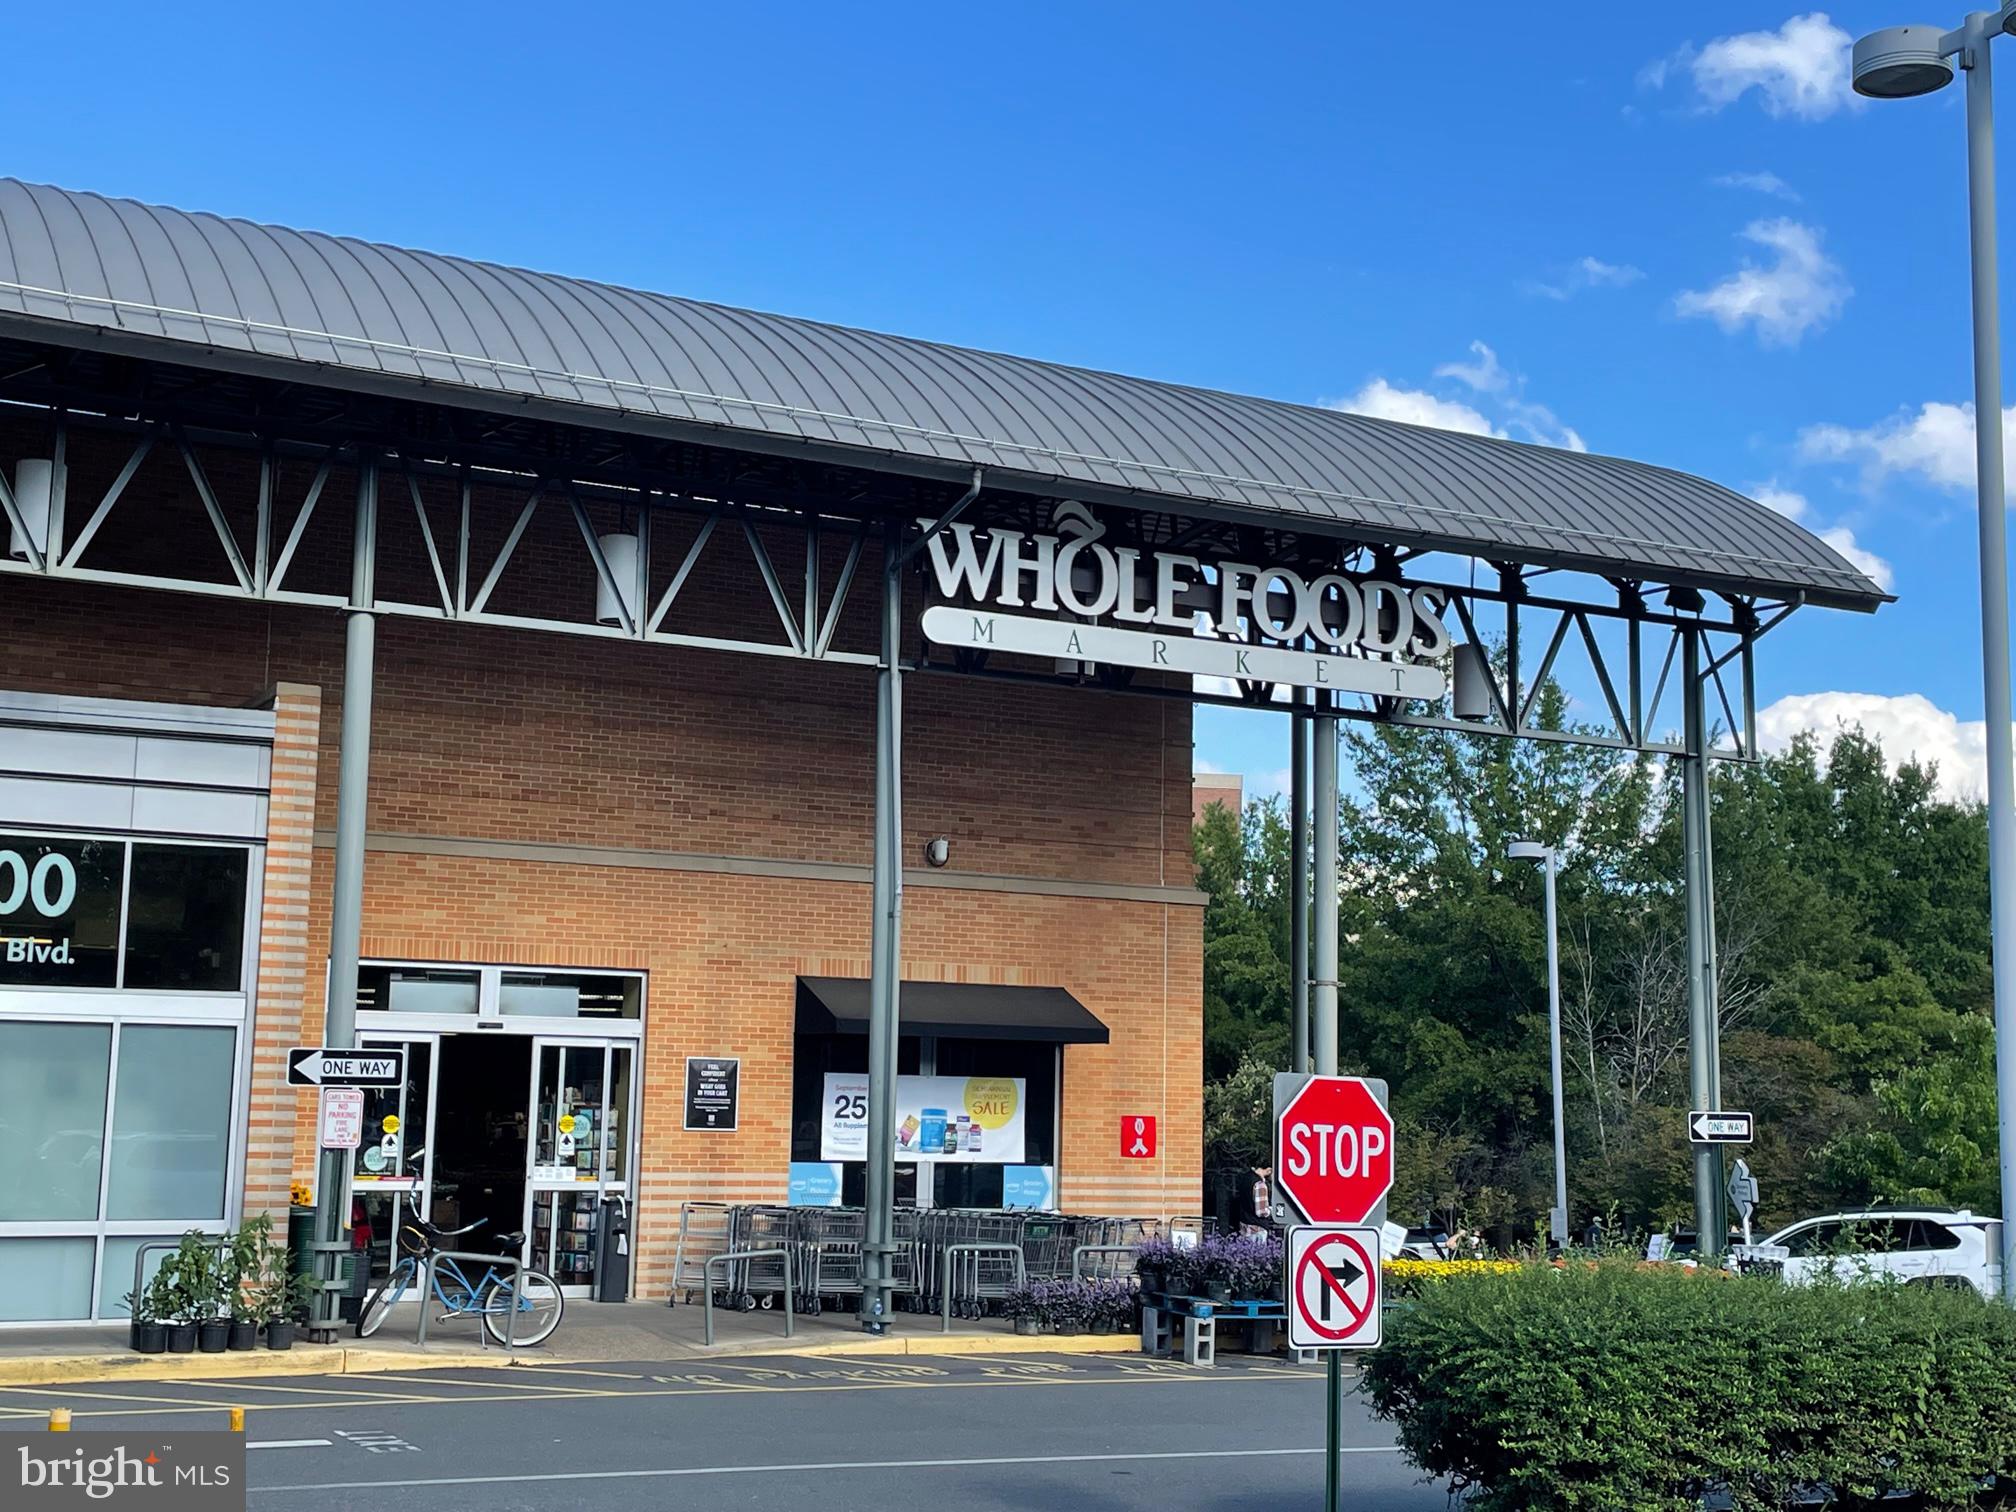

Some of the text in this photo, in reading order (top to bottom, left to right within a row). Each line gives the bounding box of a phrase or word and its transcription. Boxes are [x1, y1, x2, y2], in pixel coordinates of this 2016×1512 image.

[916, 500, 1451, 657] WHOLE FOODS
[972, 616, 1405, 691] MARKET
[7, 936, 75, 964] Blvd.
[322, 1060, 391, 1075] ONE WAY
[328, 1111, 357, 1119] PARKING
[972, 1100, 1009, 1115] SALE
[833, 1121, 842, 1129] All
[1708, 1122, 1744, 1133] ONE WAY
[1288, 1122, 1385, 1178] STOP
[650, 1374, 722, 1383] NO
[744, 1366, 950, 1382] PARKING
